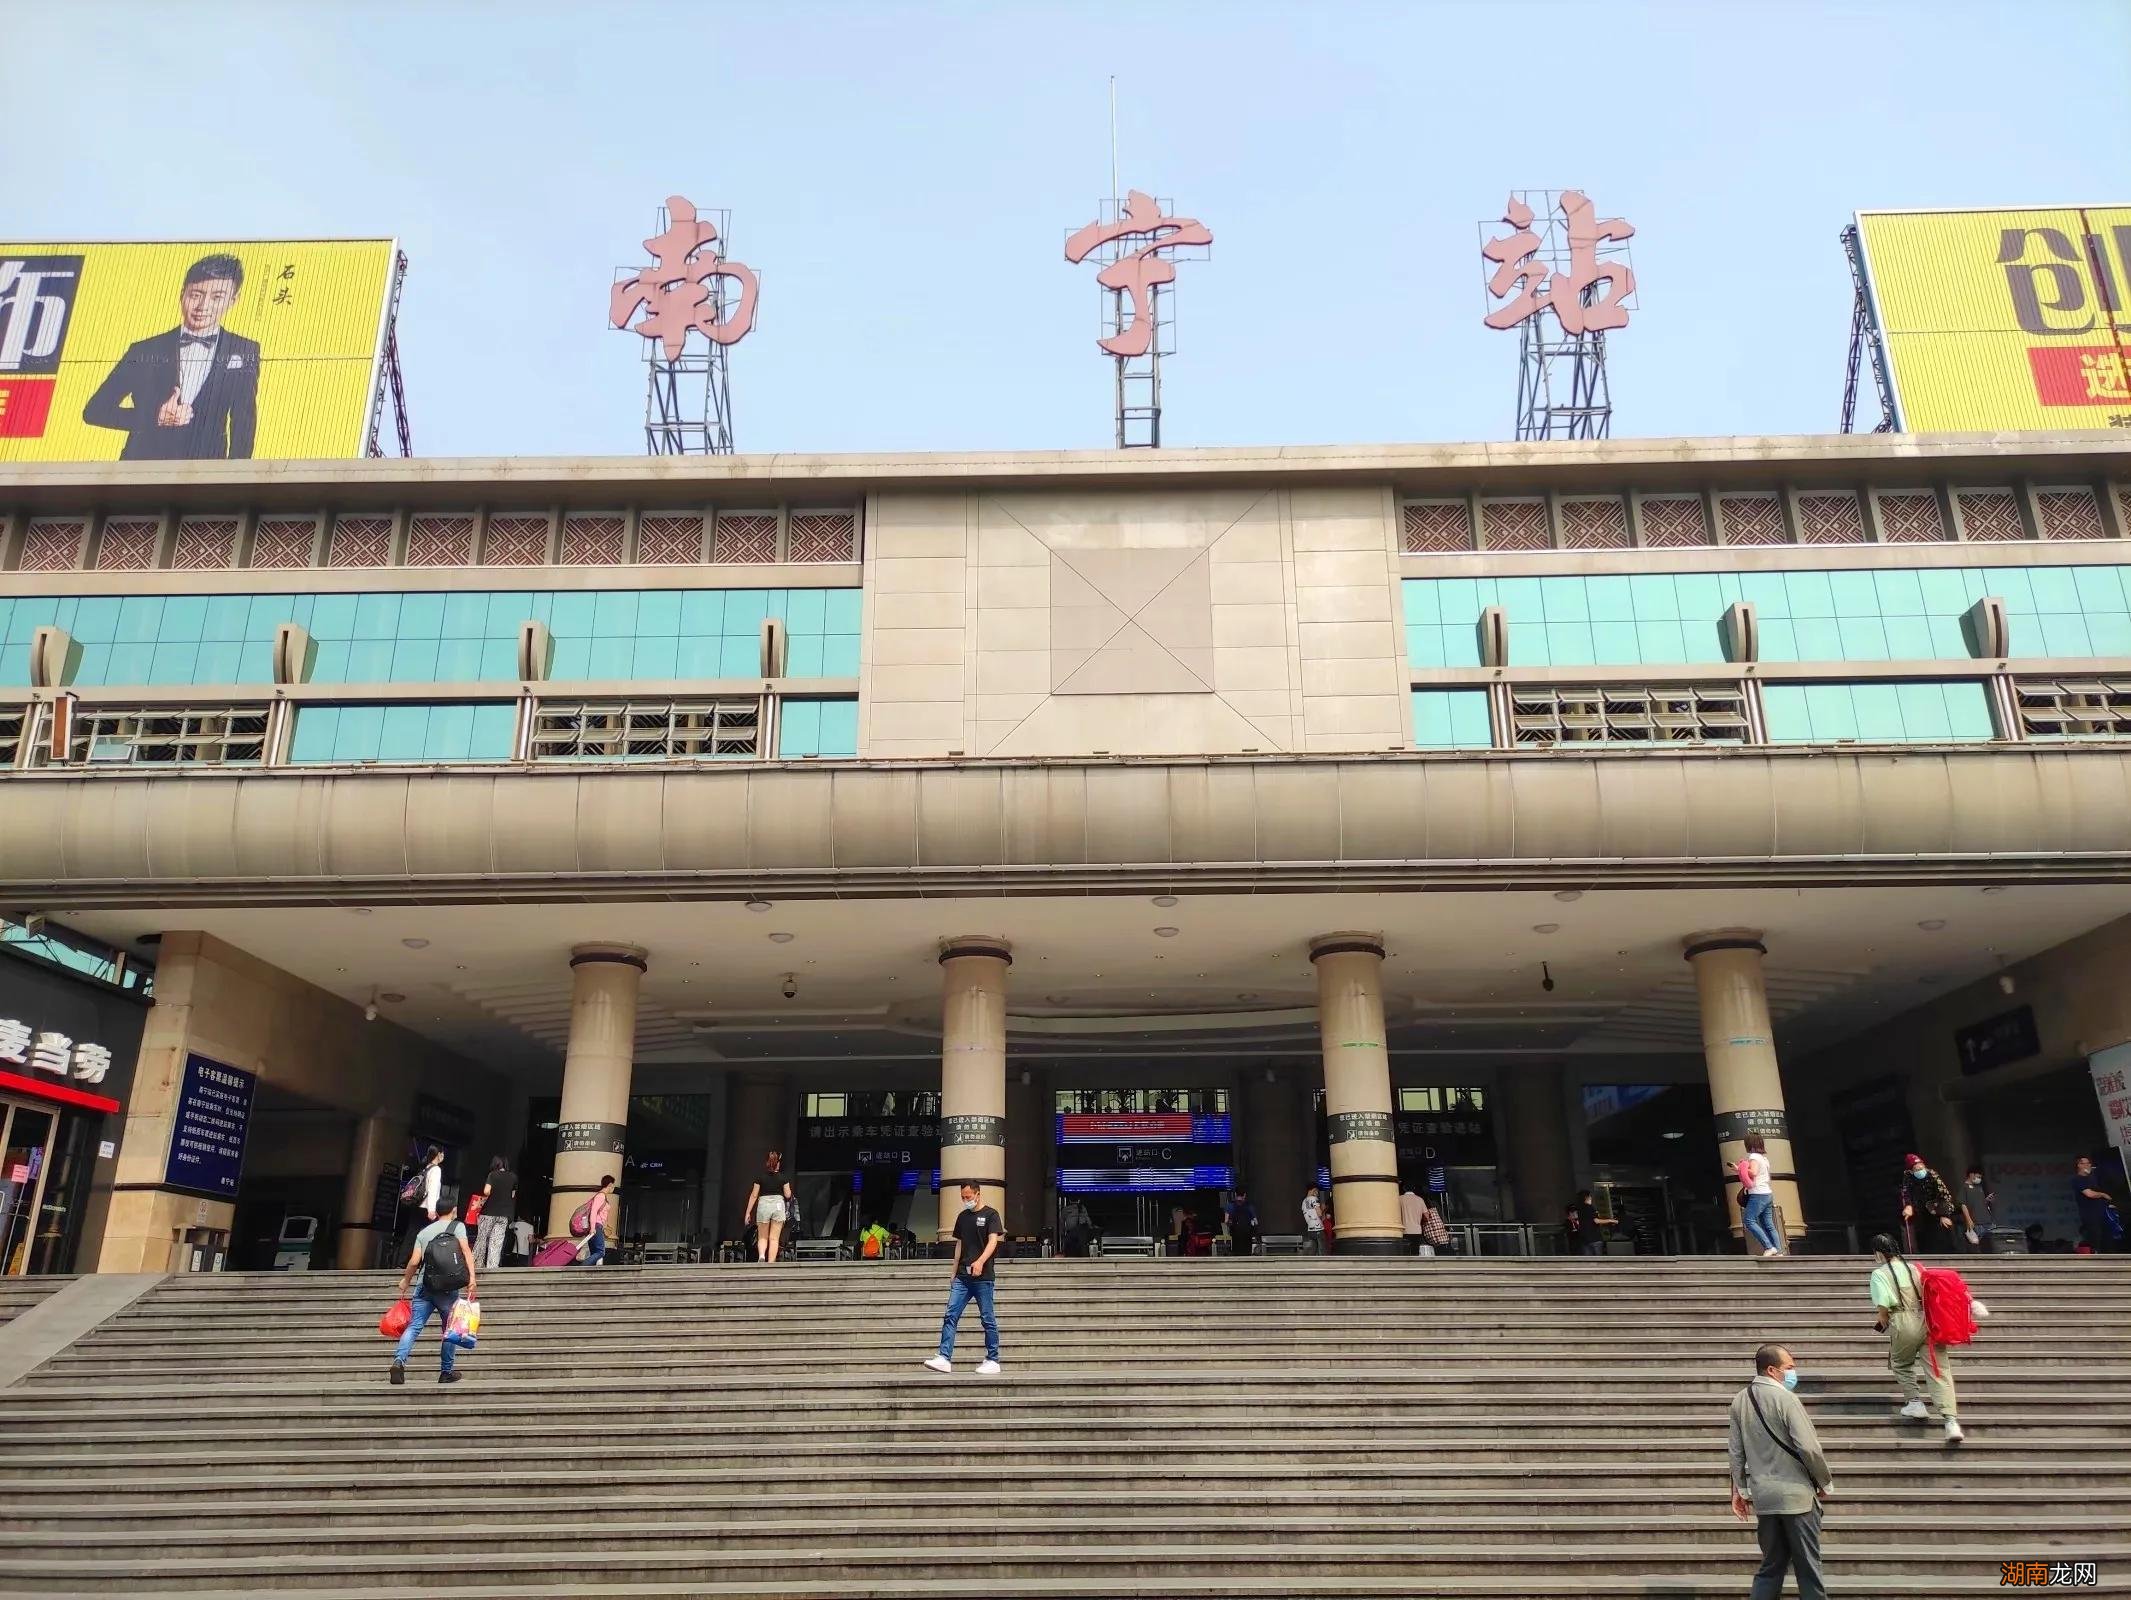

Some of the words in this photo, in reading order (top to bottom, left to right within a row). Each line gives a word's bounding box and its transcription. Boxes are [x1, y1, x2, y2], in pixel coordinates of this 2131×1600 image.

[273, 264, 296, 305] 石头
[2080, 352, 2131, 398] 选
[0, 1018, 112, 1083] 麦当劳
[901, 1151, 911, 1163] B
[1162, 1148, 1172, 1160] C
[1426, 1147, 1436, 1159] D
[625, 1155, 635, 1167] A
